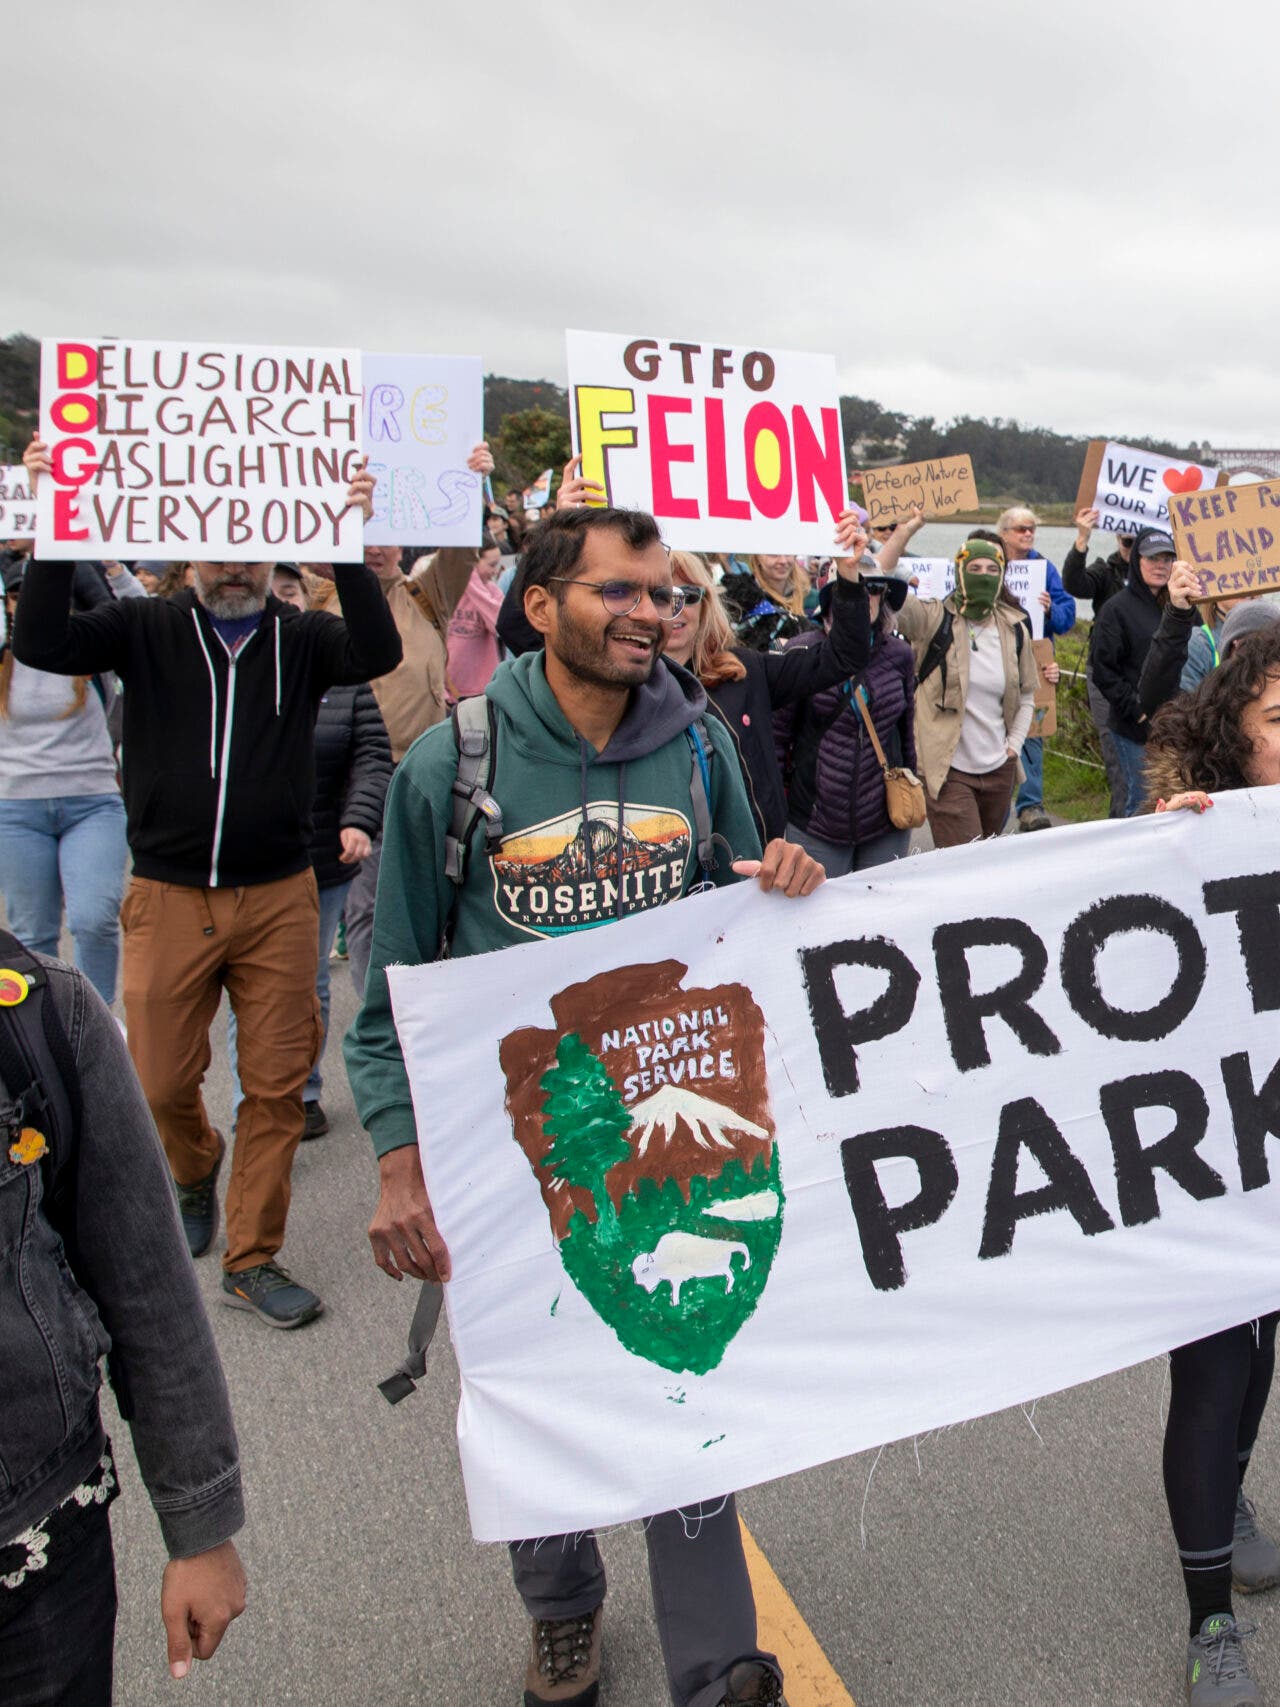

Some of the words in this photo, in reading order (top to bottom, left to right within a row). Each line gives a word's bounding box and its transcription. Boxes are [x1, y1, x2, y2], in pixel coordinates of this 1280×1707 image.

[56, 343, 362, 397] DELUSIONAL
[623, 340, 776, 392] GTFO
[50, 392, 356, 442] OLIGARCH
[362, 384, 449, 446] RE
[50, 437, 362, 490] GASLIGHTING
[574, 384, 845, 524] FELON
[865, 466, 922, 495] Defend
[925, 459, 969, 483] Nature
[1107, 458, 1158, 494] WE
[53, 485, 352, 547] EVERYBODY
[869, 484, 925, 521] Defund
[932, 486, 963, 510] War
[1102, 515, 1144, 537] RAN
[1104, 493, 1147, 515] OUR
[1175, 490, 1238, 527] KEEP
[1186, 526, 1275, 564] LAND
[502, 858, 685, 915] YOSEMITE
[522, 908, 615, 924] NATIONAL
[628, 892, 669, 912] PARK
[600, 1004, 729, 1054] NATIONAL
[636, 1029, 712, 1069] PARK
[623, 1048, 737, 1102] SERVICE
